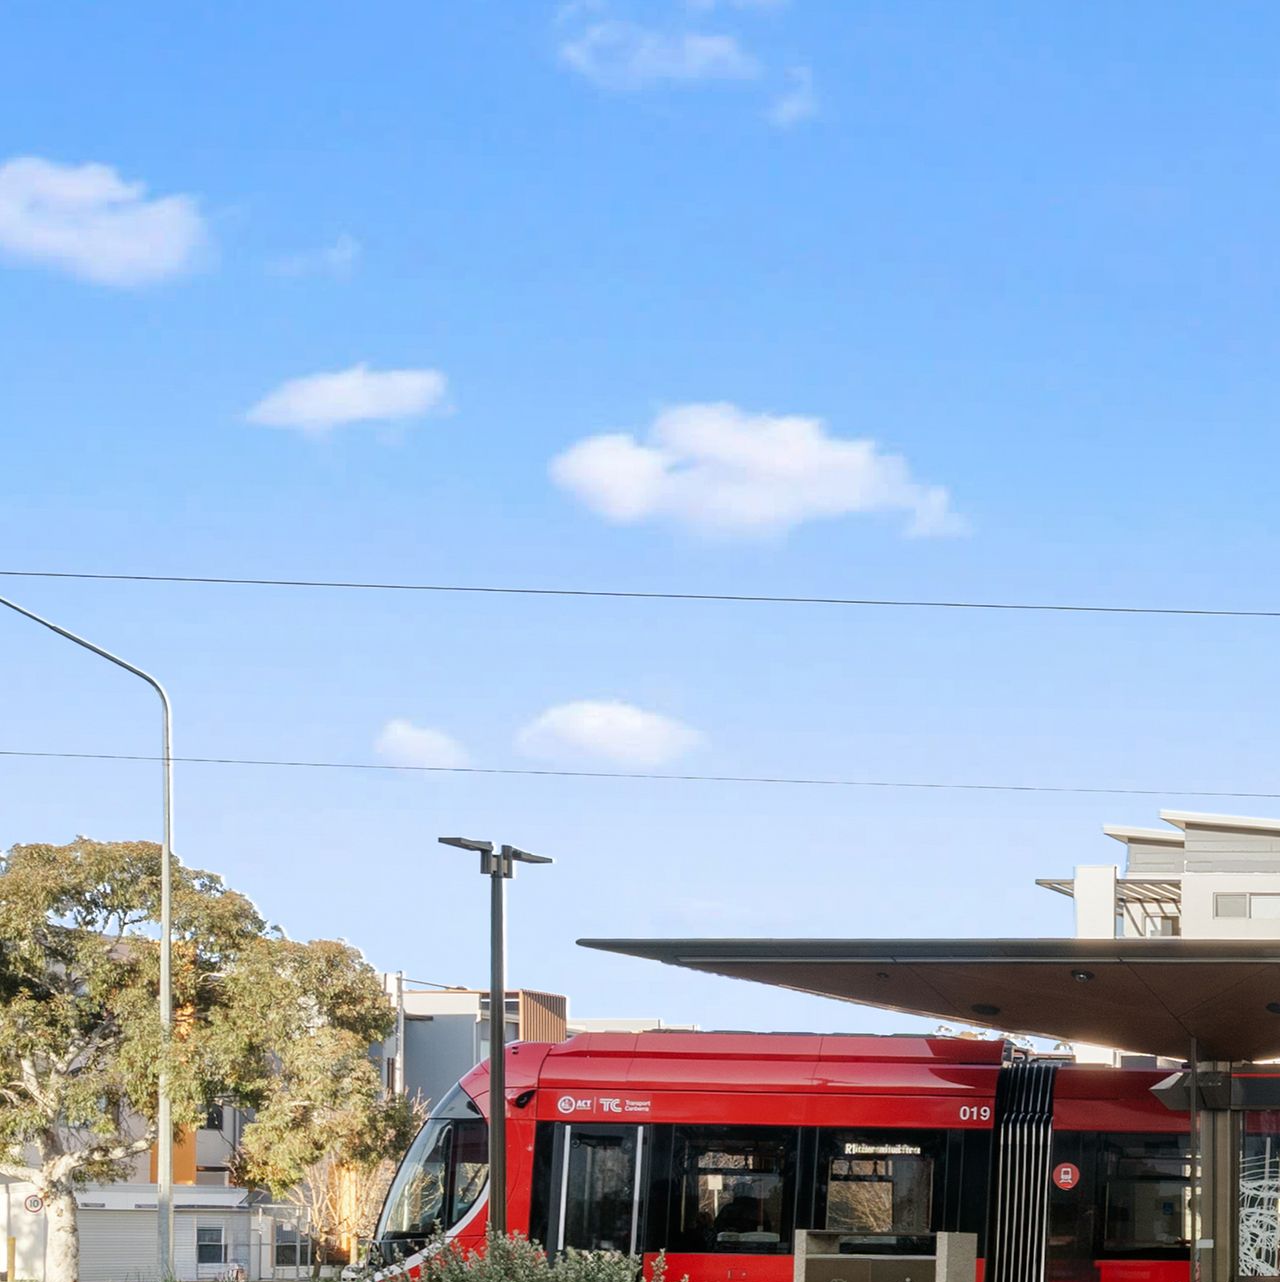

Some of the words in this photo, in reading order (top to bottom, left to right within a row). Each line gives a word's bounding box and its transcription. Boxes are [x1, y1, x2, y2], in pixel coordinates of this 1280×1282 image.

[600, 1098, 622, 1112] TC
[959, 1105, 991, 1121] 019
[29, 1199, 40, 1208] 10
